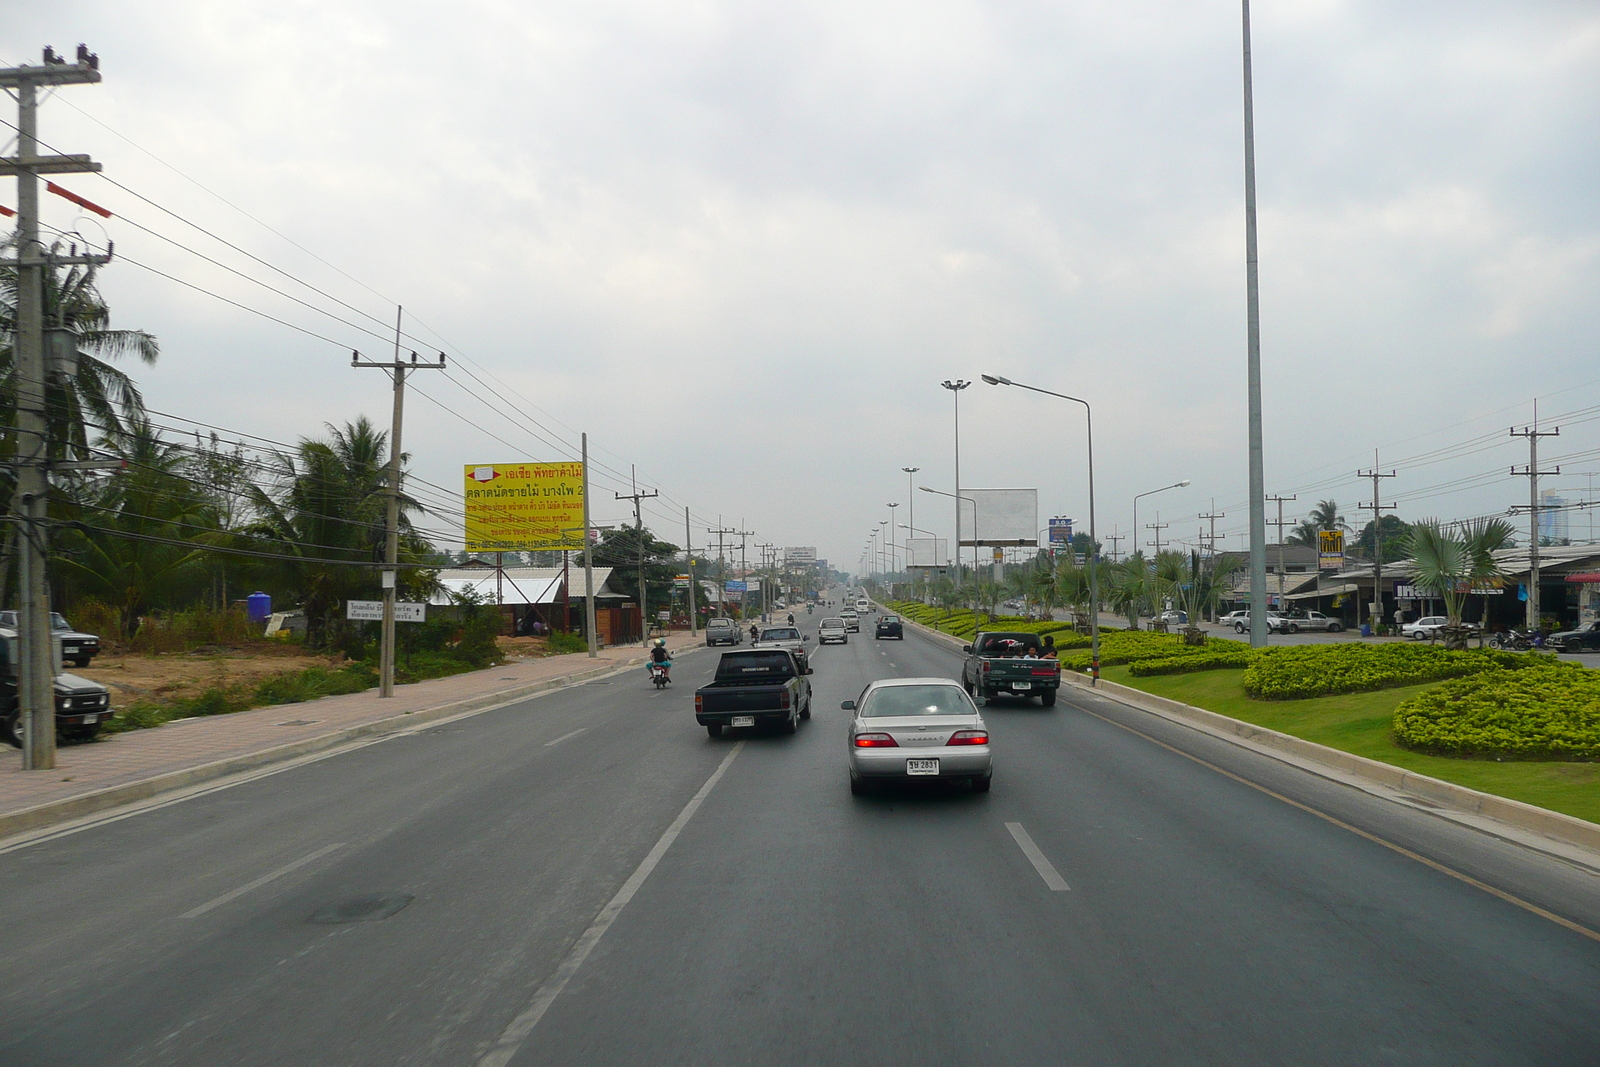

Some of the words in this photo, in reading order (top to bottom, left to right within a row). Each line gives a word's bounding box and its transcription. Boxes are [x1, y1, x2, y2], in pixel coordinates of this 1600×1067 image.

[534, 464, 582, 478] พัทยาค้าไม้
[466, 483, 539, 498] ตลาดนัดขายไม้
[543, 482, 574, 497] บางโพ
[577, 485, 584, 496] 2
